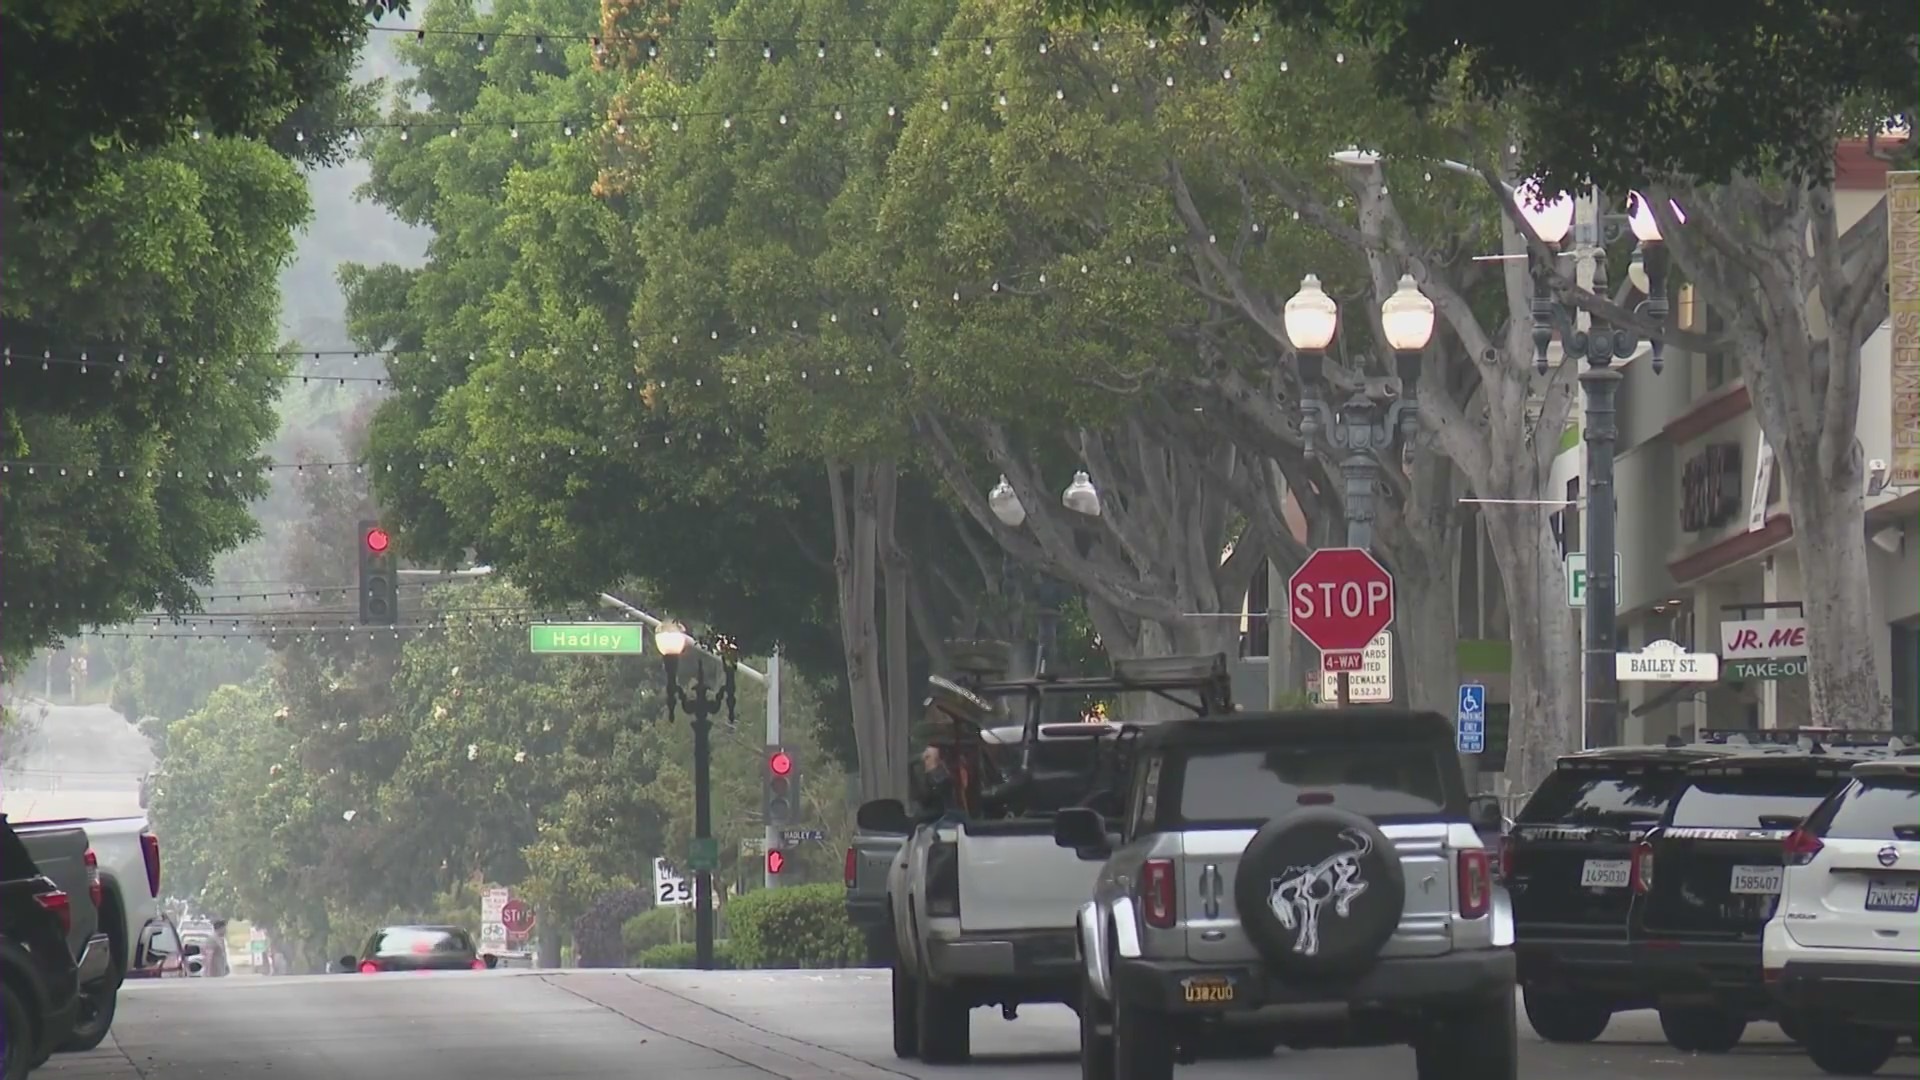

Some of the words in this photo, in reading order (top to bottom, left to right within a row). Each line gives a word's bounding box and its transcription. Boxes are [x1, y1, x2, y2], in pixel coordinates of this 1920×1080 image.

[1894, 311, 1919, 449] FARMERS
[1294, 581, 1388, 619] STOP
[553, 631, 621, 650] Hadley
[1727, 629, 1763, 652] JR.
[1768, 626, 1805, 649] ME
[1363, 649, 1387, 659] ARDS
[1325, 655, 1361, 669] 4-WAY
[1363, 661, 1381, 671] ITED
[1631, 658, 1676, 673] BAILEY
[1679, 658, 1698, 673] ST.
[1735, 662, 1807, 678] TAKE-OU
[1349, 675, 1387, 685] DEWALKS
[1663, 827, 1739, 840] WHITTIER
[659, 883, 692, 902] 25
